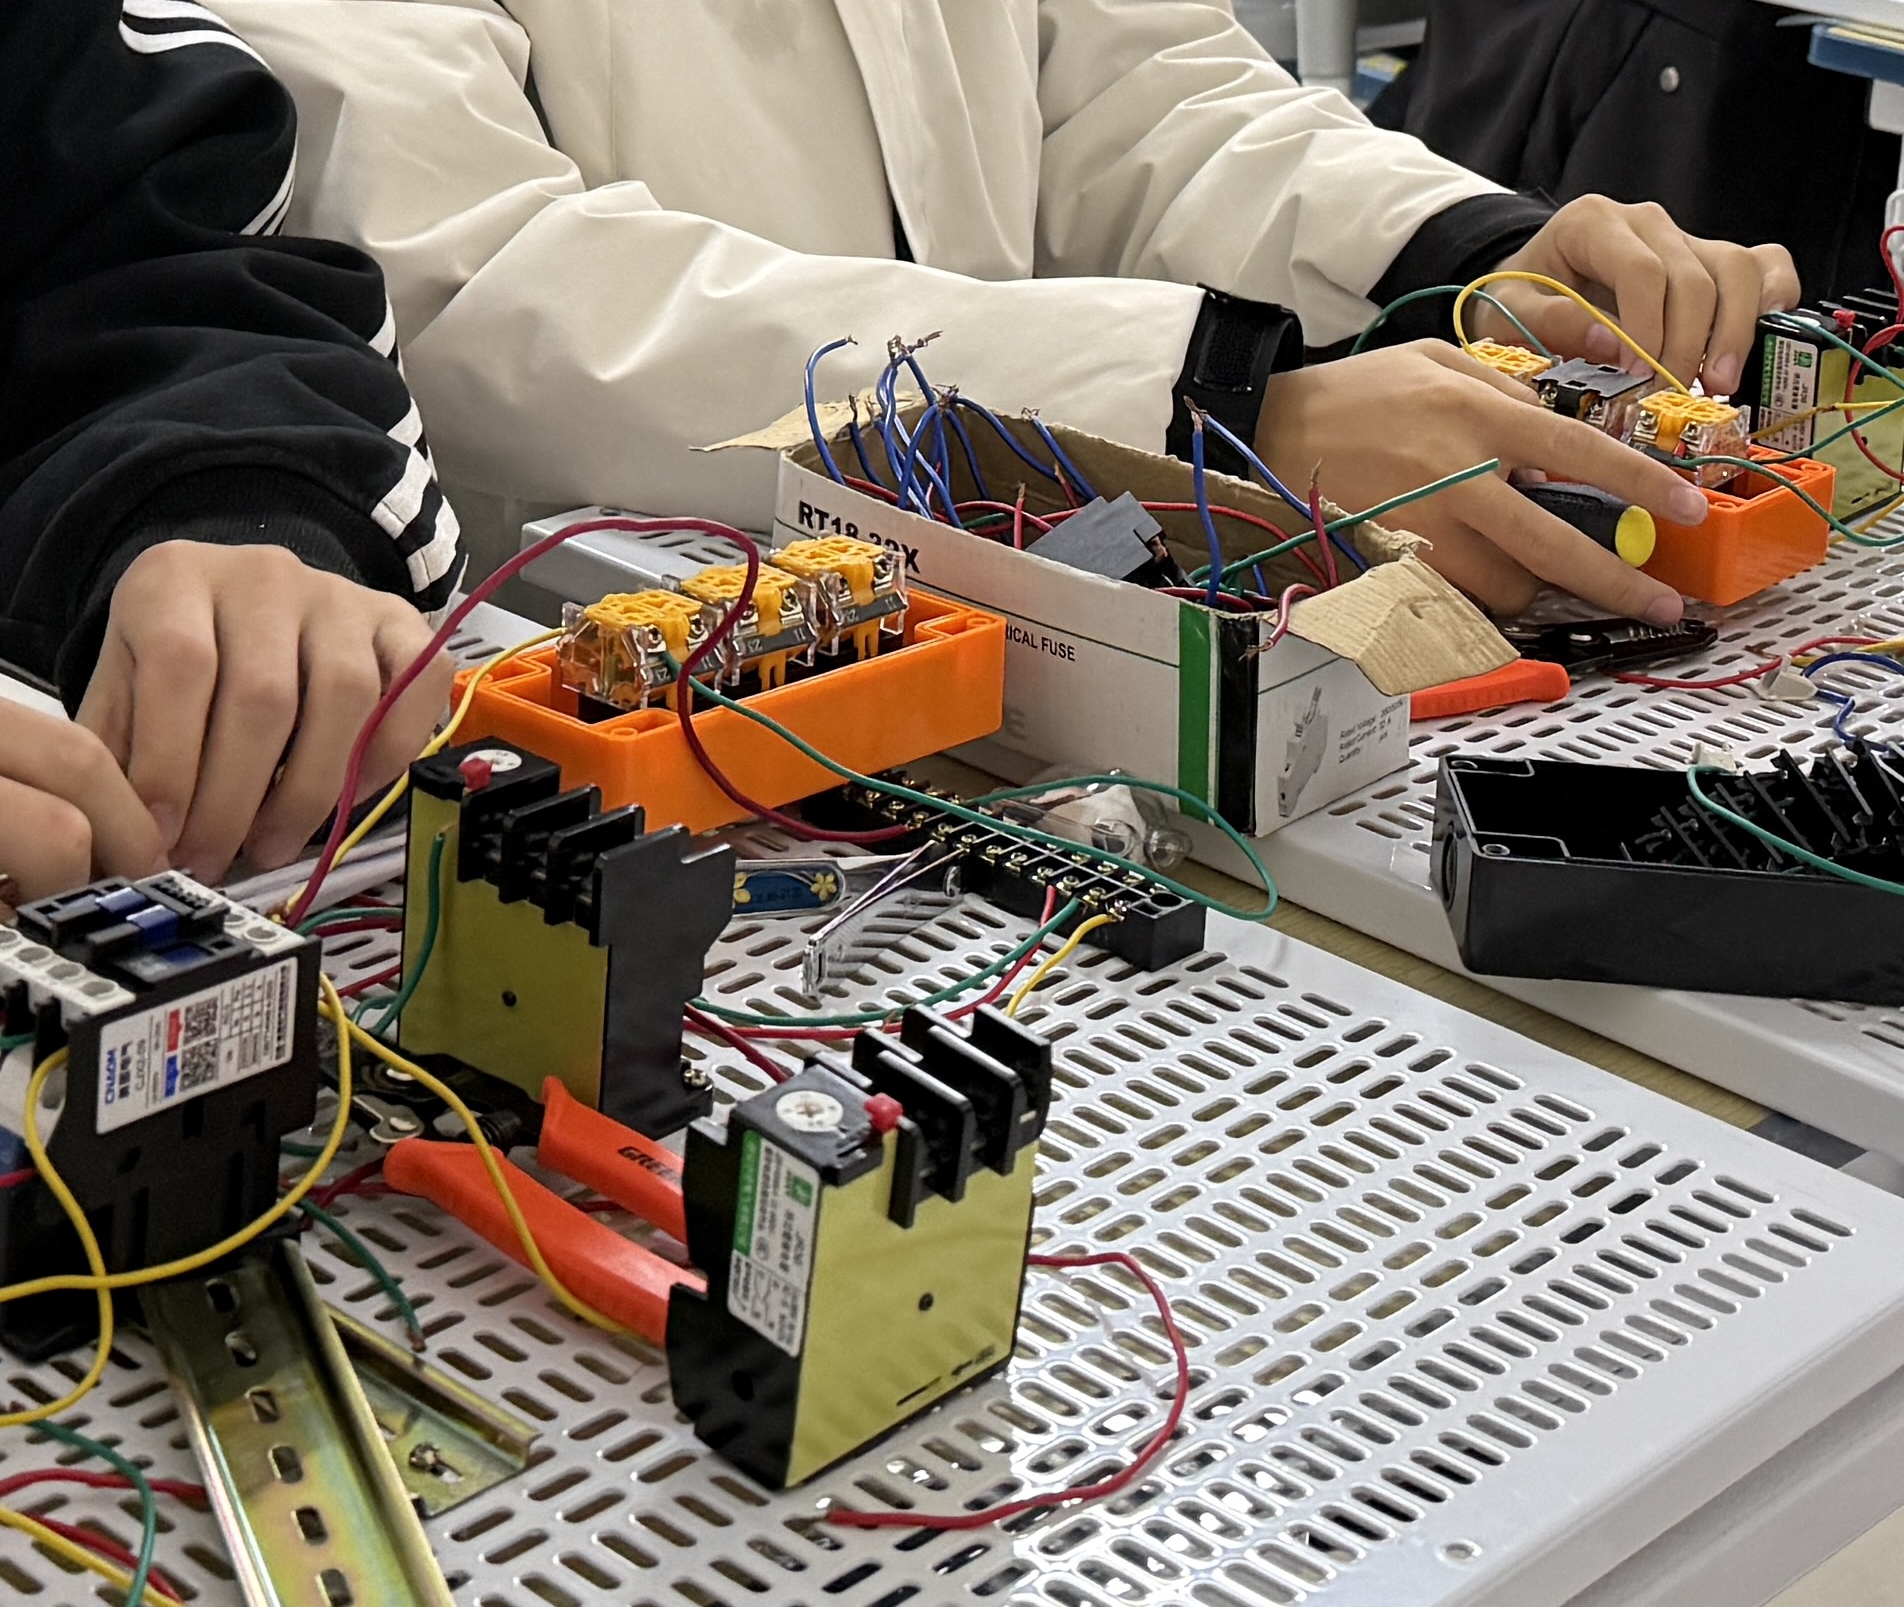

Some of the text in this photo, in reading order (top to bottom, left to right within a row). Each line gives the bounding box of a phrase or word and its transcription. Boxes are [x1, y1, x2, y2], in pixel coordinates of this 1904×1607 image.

[799, 500, 920, 574] RT1832X
[1006, 624, 1076, 662] ICAL FUSE
